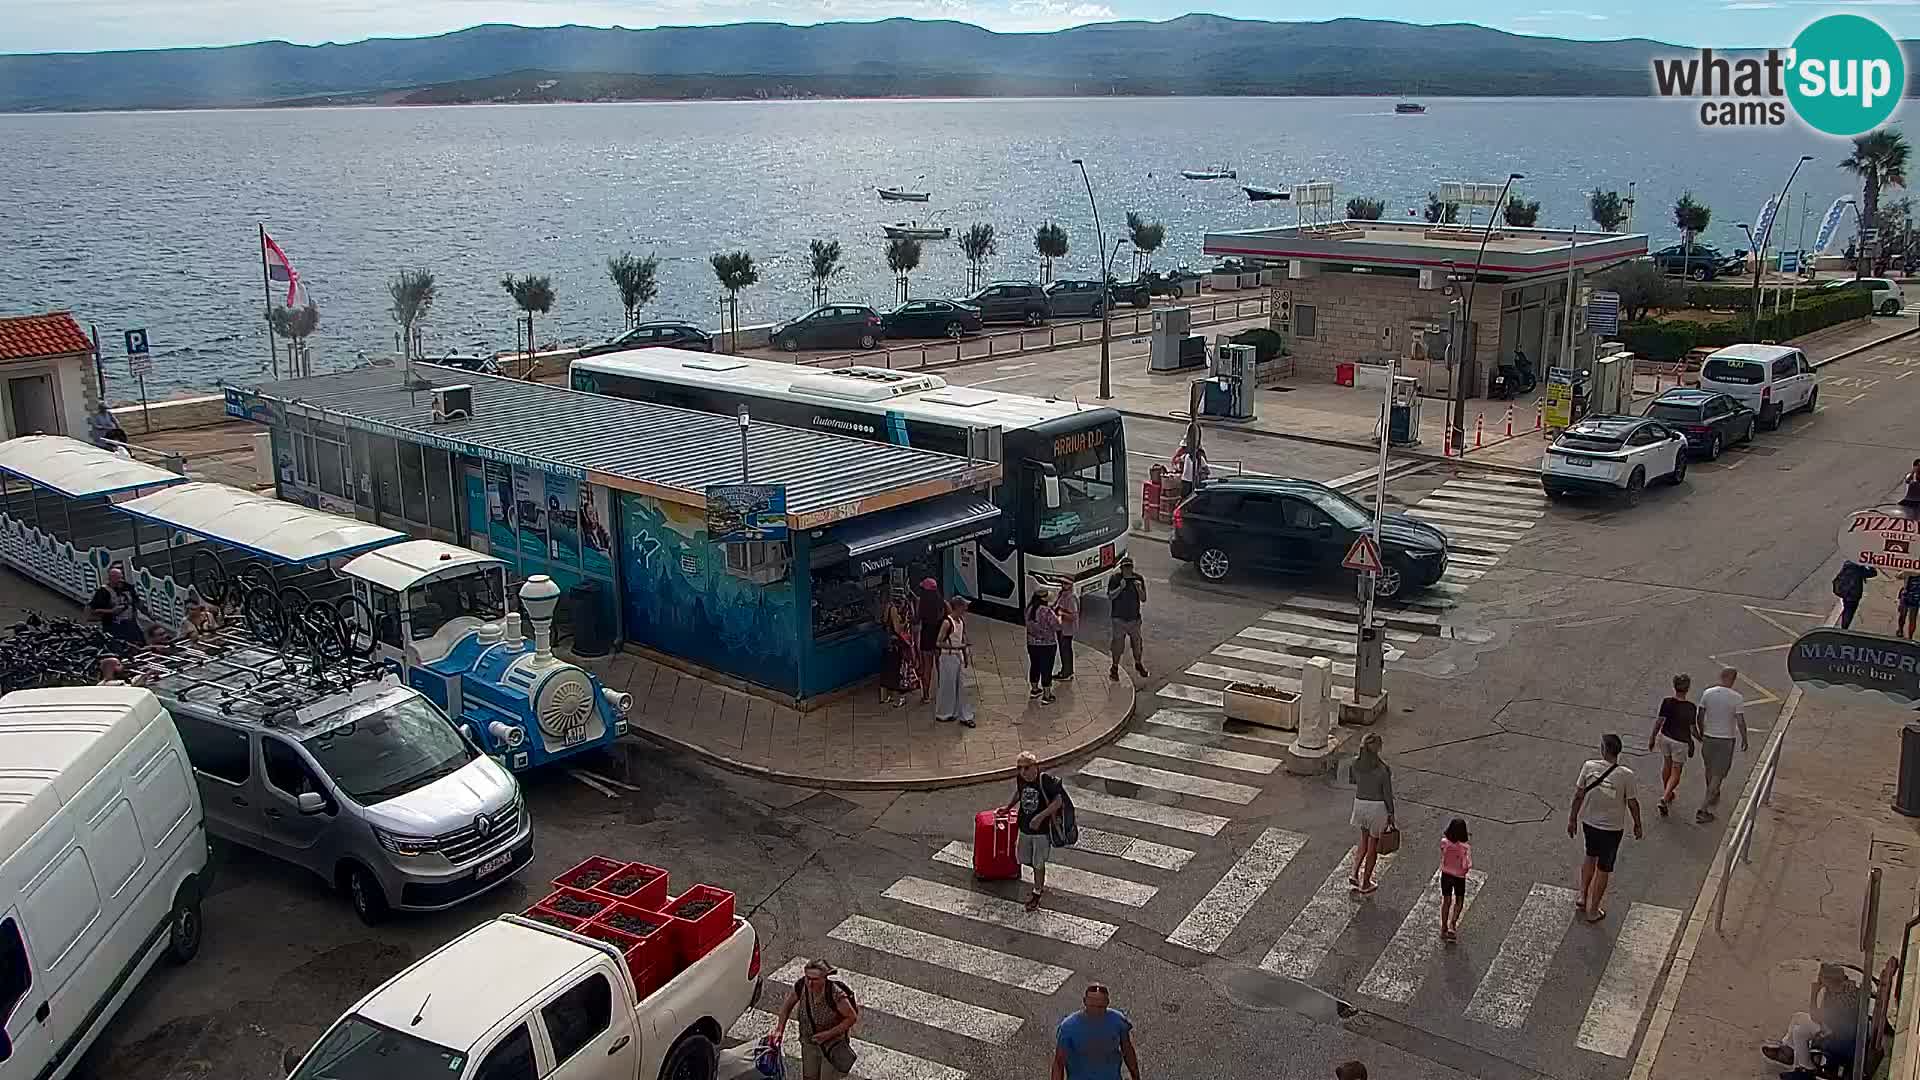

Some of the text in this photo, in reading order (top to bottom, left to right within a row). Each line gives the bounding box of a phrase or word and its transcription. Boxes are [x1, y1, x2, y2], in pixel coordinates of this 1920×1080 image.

[130, 332, 144, 351] P
[1727, 360, 1744, 369] TAXI
[494, 450, 526, 466] STATION
[527, 458, 554, 473] TICKET
[555, 464, 582, 479] OFFICE
[1848, 517, 1920, 534] PIZZE
[1881, 532, 1916, 541] GRILL
[1076, 554, 1099, 569] IVEC
[1870, 667, 1896, 681] bar
